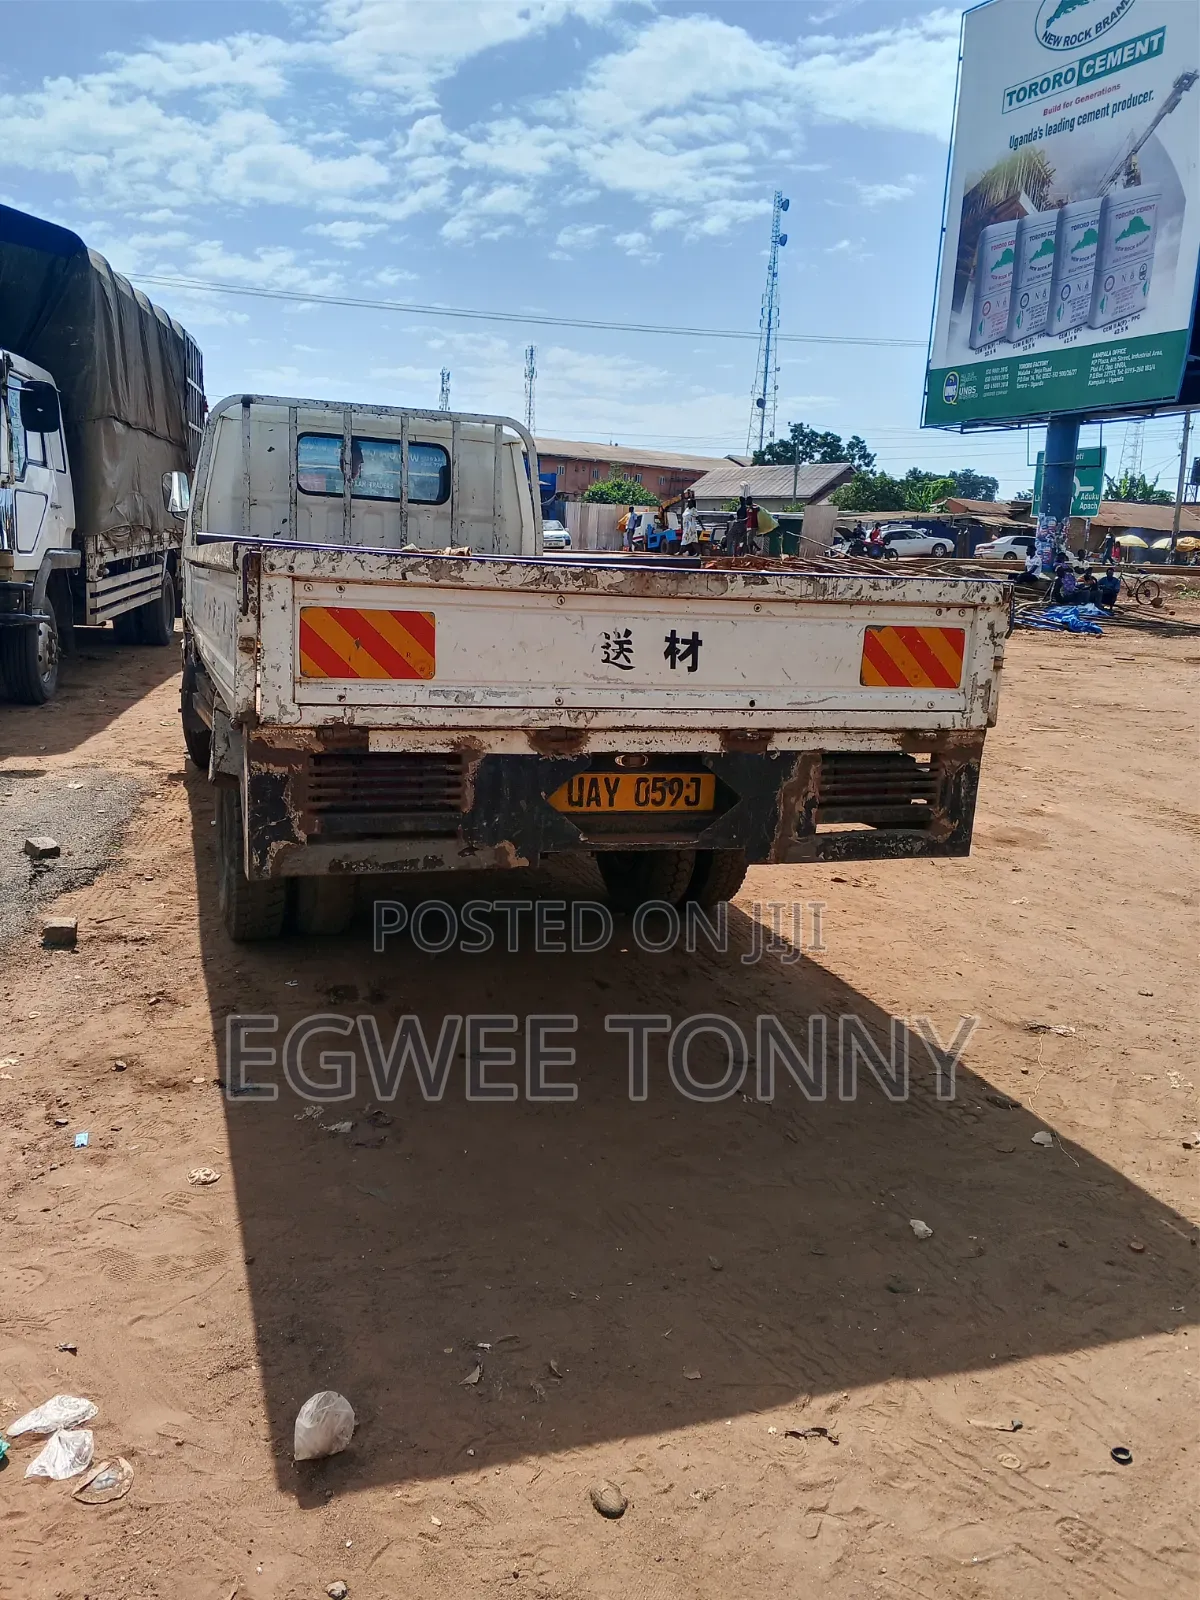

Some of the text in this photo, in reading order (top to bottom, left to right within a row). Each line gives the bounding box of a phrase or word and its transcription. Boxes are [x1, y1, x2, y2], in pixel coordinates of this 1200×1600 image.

[1041, 30, 1063, 47] NEW
[1063, 27, 1093, 47] ROCK
[1006, 31, 1164, 107] TORORO CEMENT
[1042, 83, 1121, 116] Build for Generations
[1009, 90, 1154, 150] Uganda's leading cement producer.
[1080, 502, 1098, 510] Apach
[566, 776, 702, 808] UAY 059J
